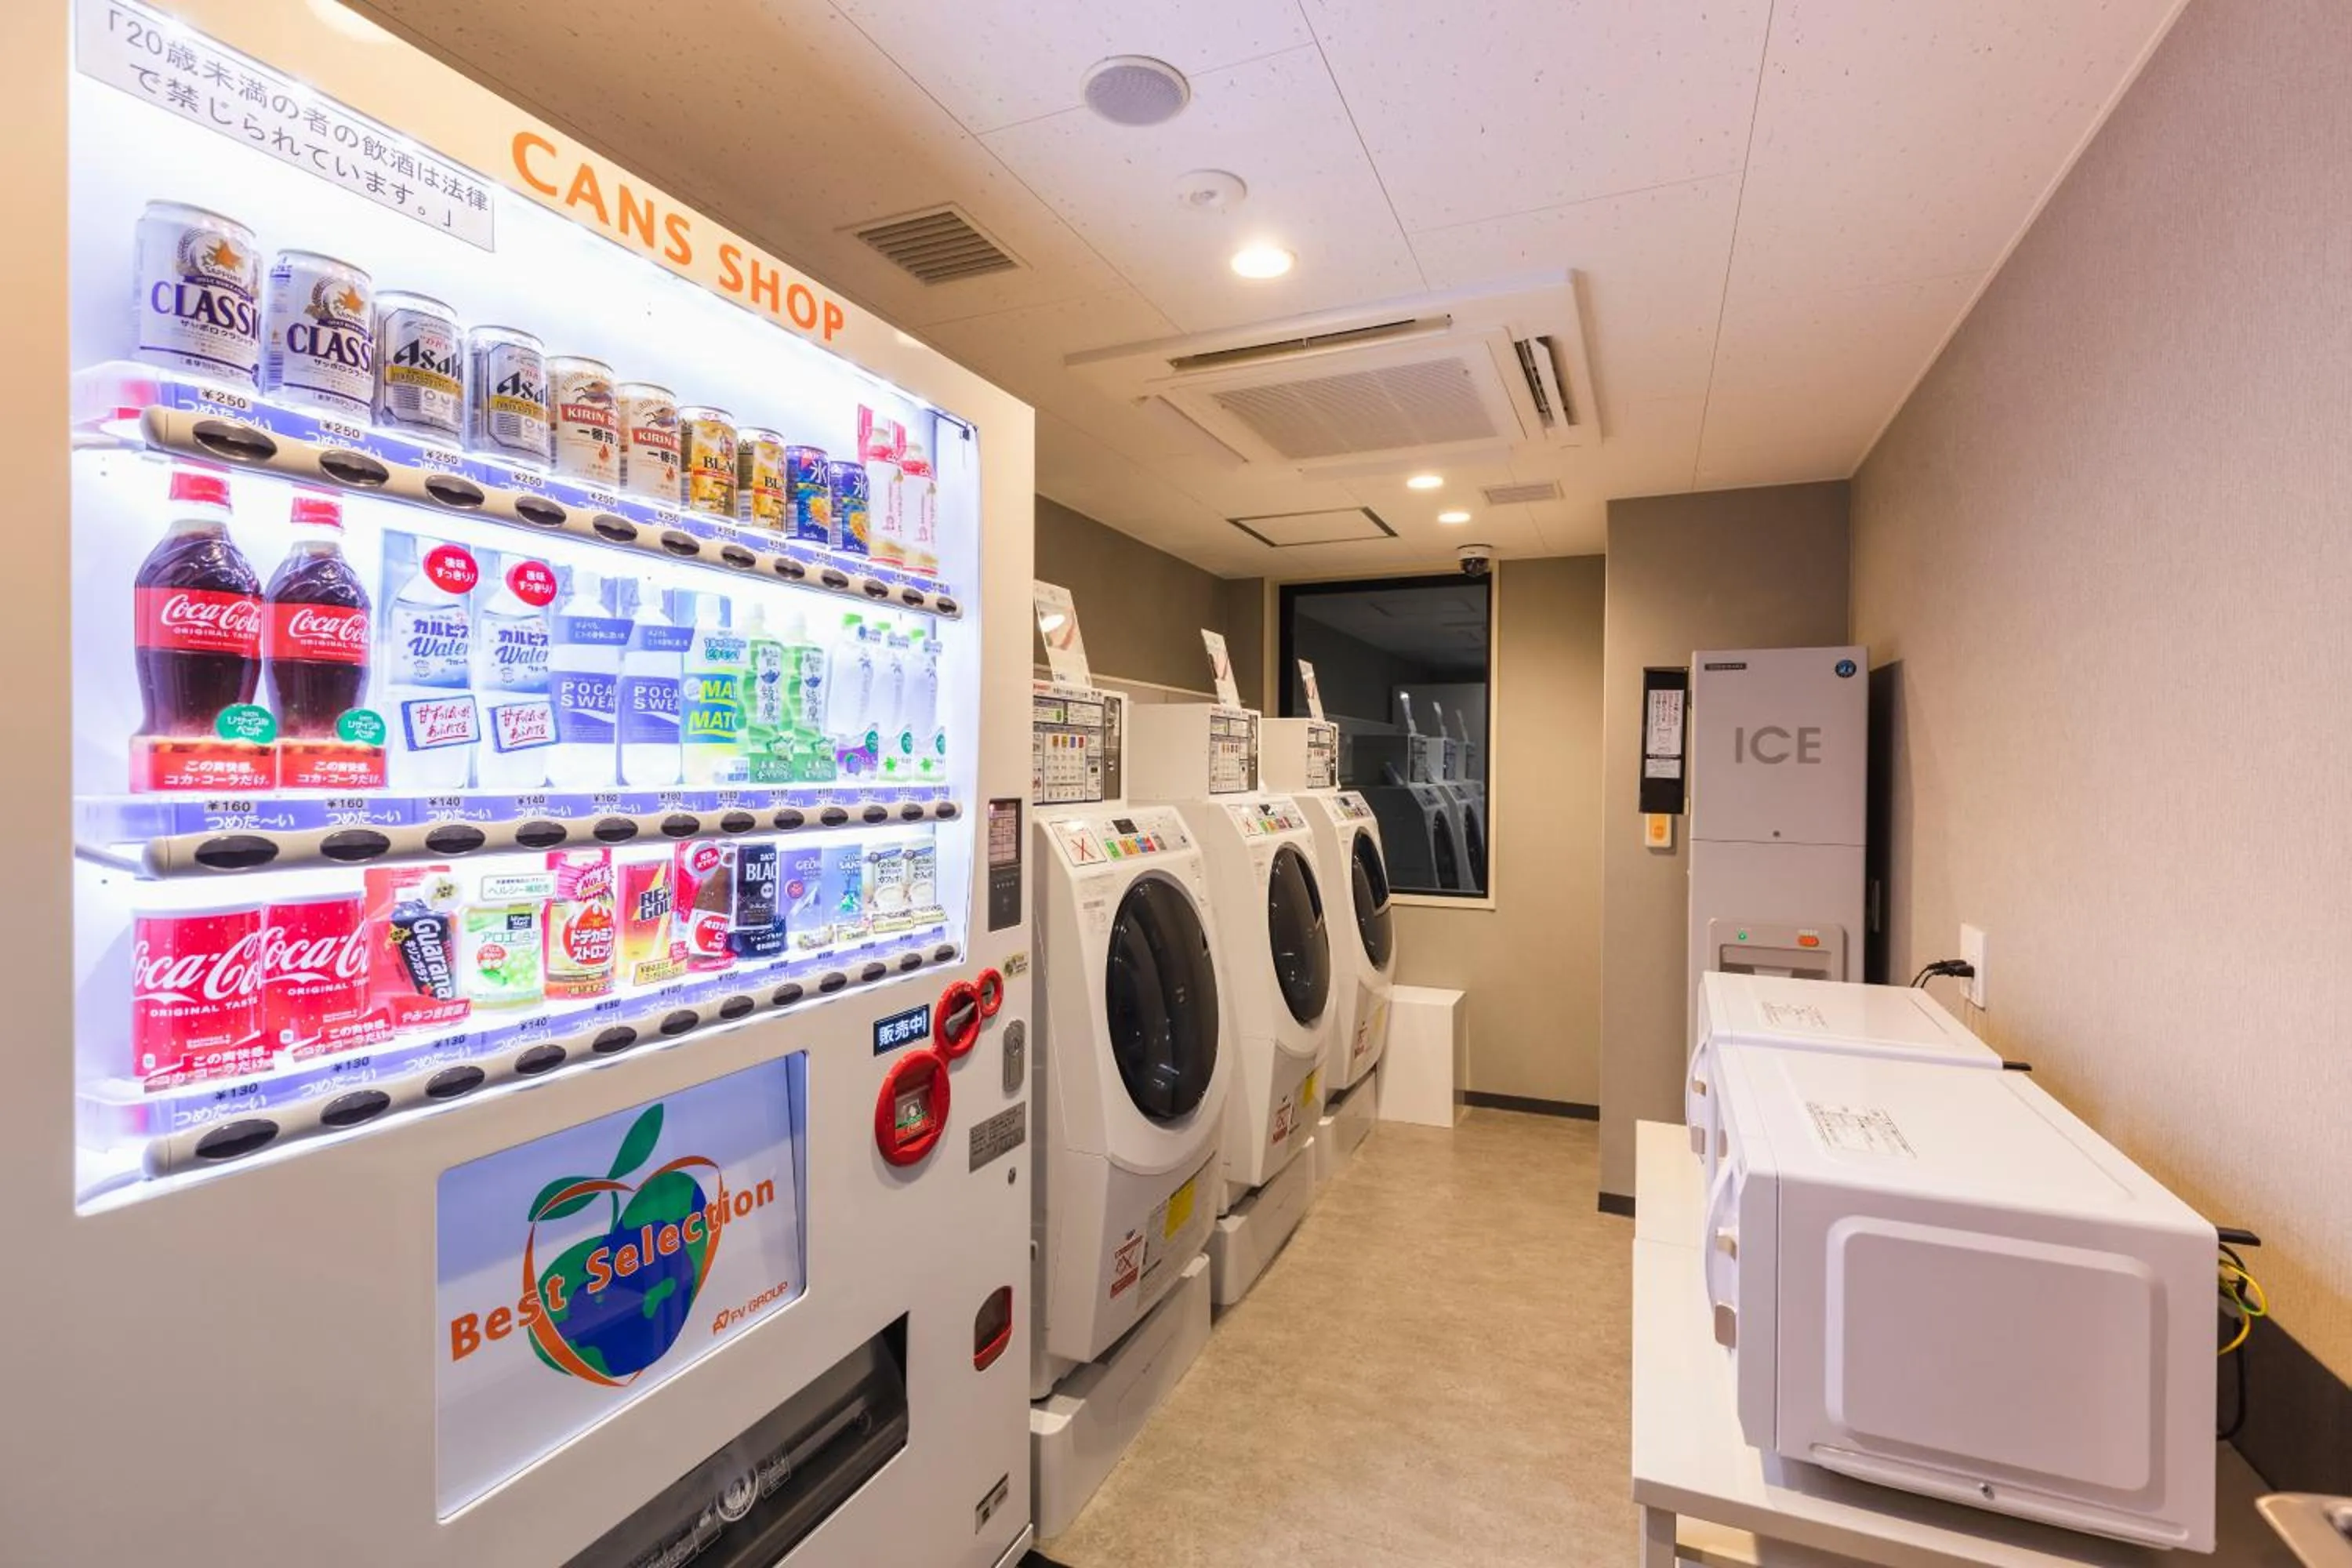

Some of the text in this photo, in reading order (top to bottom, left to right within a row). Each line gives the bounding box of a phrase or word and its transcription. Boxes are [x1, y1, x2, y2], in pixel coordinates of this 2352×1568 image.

[107, 9, 488, 212] 「20歳未満の者の飲酒は法律
[130, 64, 452, 227] で禁じられています。」
[512, 131, 844, 341] CANS SHOP
[201, 387, 247, 409] ¥250
[567, 407, 605, 424] KIRIN
[321, 419, 361, 439] ¥250
[637, 431, 673, 446] KIRIN
[426, 450, 459, 465] ¥250
[514, 471, 543, 486] ¥250
[1735, 725, 1822, 765] ICE
[205, 800, 252, 813] ¥160
[327, 798, 365, 809] ¥160
[428, 797, 461, 807] ¥140
[517, 795, 546, 805] ¥140
[746, 862, 778, 882] BLAC
[413, 918, 453, 999] Guarana
[288, 983, 349, 996] ORIGINAL
[150, 1005, 220, 1017] ORIGINAL
[879, 1014, 923, 1047] 販売中
[434, 1034, 466, 1048] ¥130
[332, 1056, 370, 1073] ¥130
[215, 1083, 258, 1101] ¥130
[450, 1178, 775, 1363] Best Selection
[748, 1280, 788, 1312] GROUP
